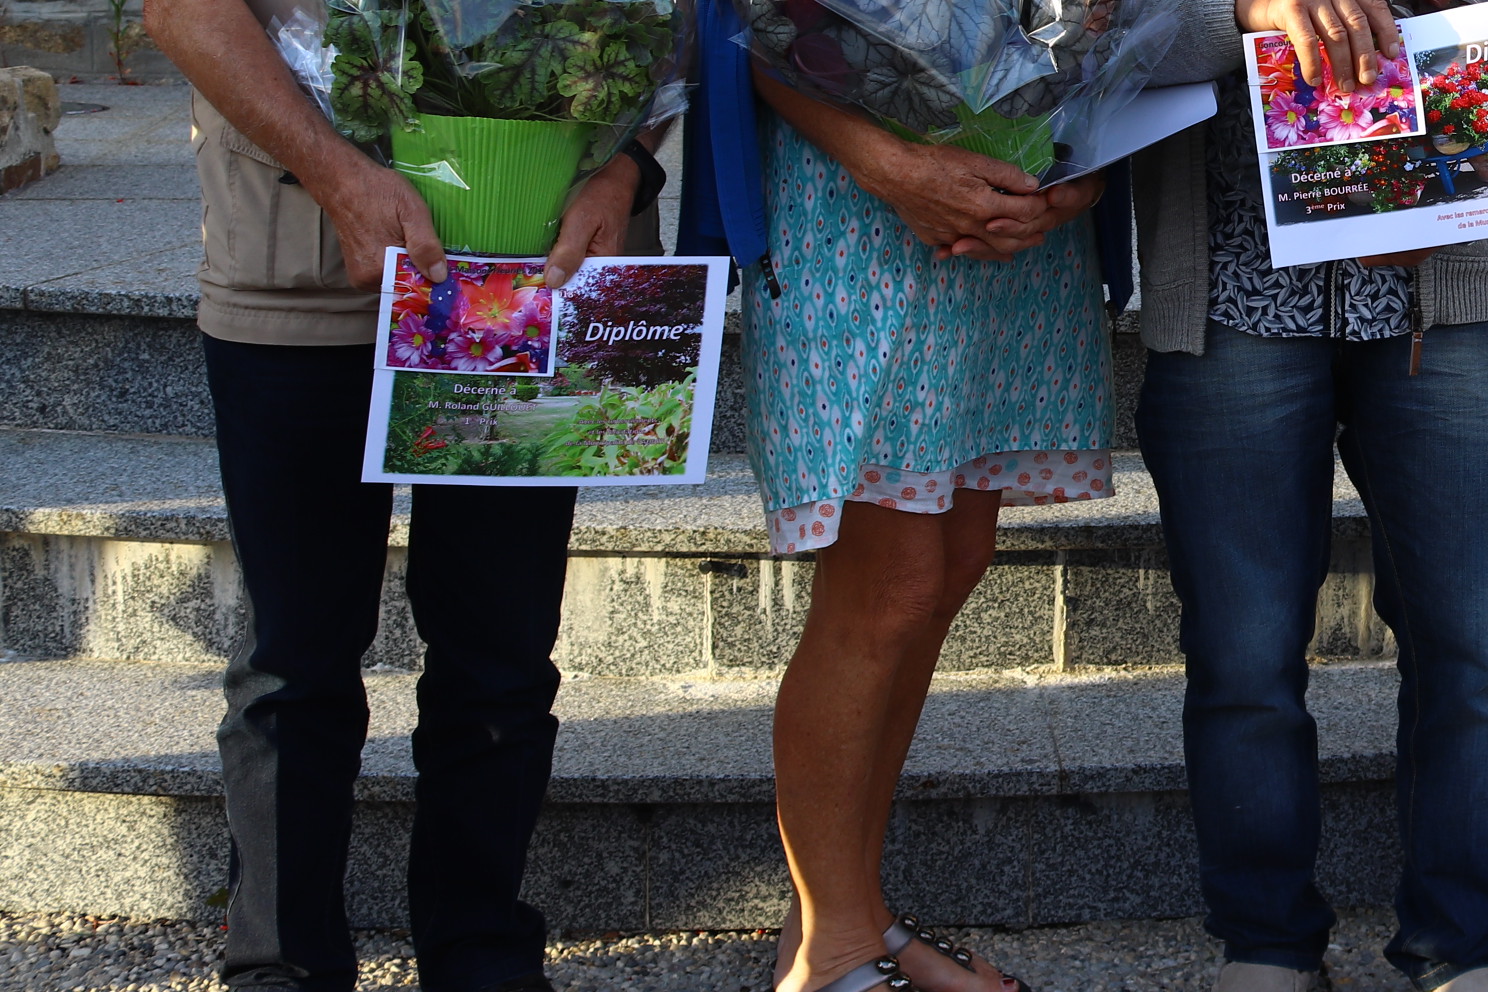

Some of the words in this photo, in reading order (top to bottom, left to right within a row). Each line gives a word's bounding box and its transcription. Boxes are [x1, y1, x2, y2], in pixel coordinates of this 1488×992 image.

[1259, 40, 1292, 49] Concour
[1291, 168, 1341, 184] Décerné
[1344, 167, 1352, 177] à
[1278, 193, 1291, 202] M.
[1293, 190, 1322, 201] Pierre
[1324, 182, 1369, 197] BOURRÉE
[1327, 202, 1346, 211] Prix
[1436, 213, 1454, 221] Avec
[1457, 221, 1467, 229] de
[584, 320, 684, 346] Diplôme
[454, 383, 506, 395] Décerné
[509, 385, 517, 395] à
[428, 401, 442, 409] M.
[444, 401, 479, 410] Roland
[479, 417, 498, 425] Prix
